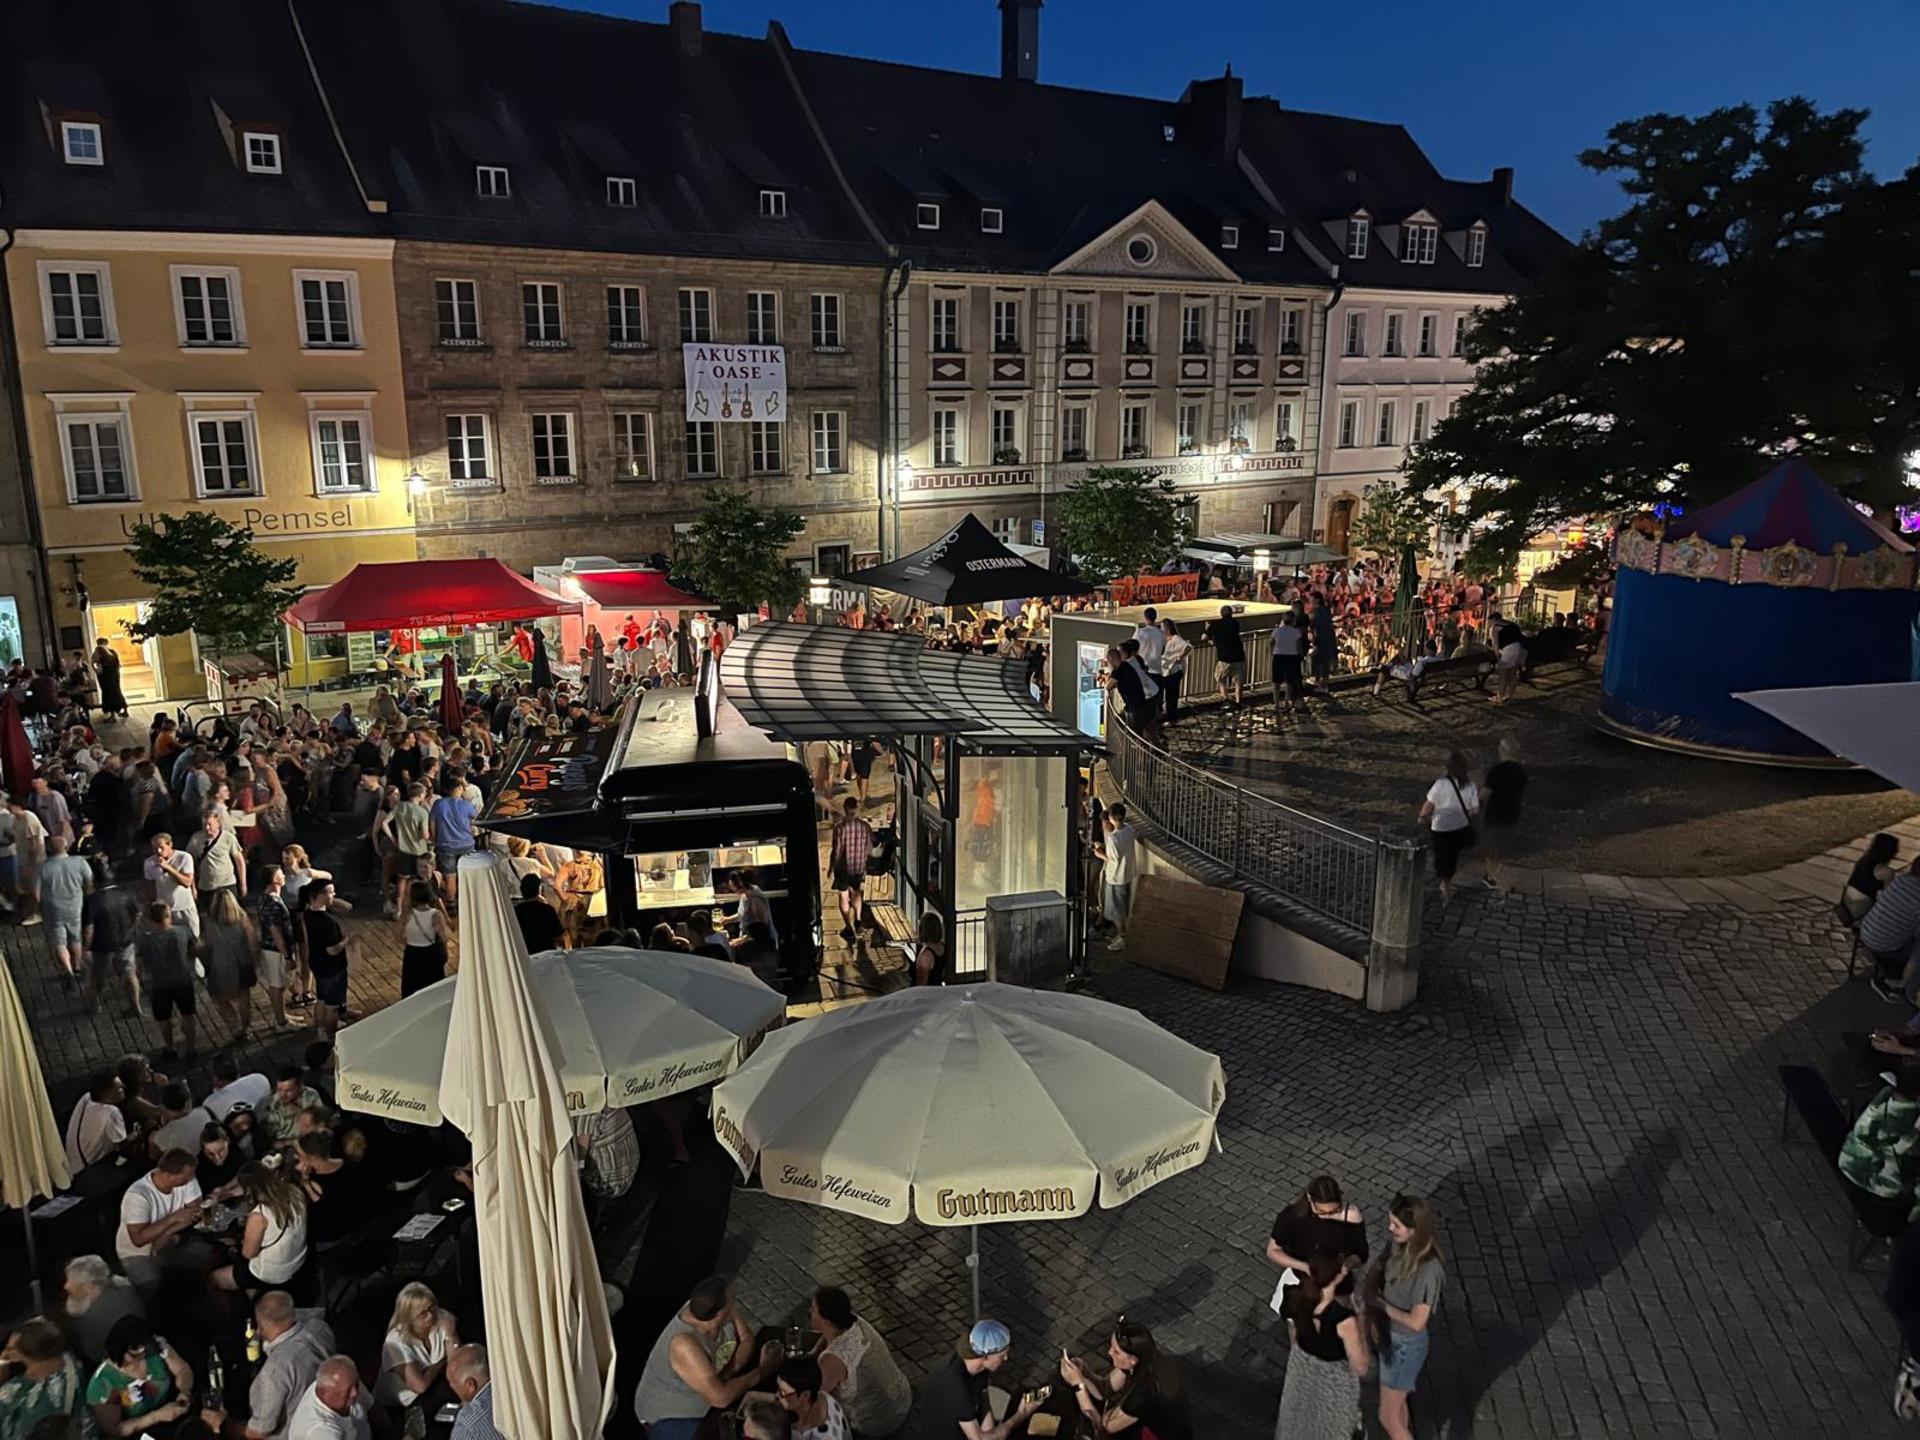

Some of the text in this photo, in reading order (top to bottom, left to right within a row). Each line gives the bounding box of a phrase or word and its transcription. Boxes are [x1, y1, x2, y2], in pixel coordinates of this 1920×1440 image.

[695, 347, 781, 363] AKUSTIK
[712, 365, 761, 379] OASE
[965, 557, 1027, 572] OSTERMANN
[623, 1058, 723, 1097] Gutes Hefeweizen
[350, 1083, 427, 1112] Gutes Hefeweizen
[1114, 1139, 1201, 1193] Gutes Hefeweizen
[780, 1164, 891, 1208] Gutes Hefeweizen
[936, 1187, 1075, 1219] Gutmann
